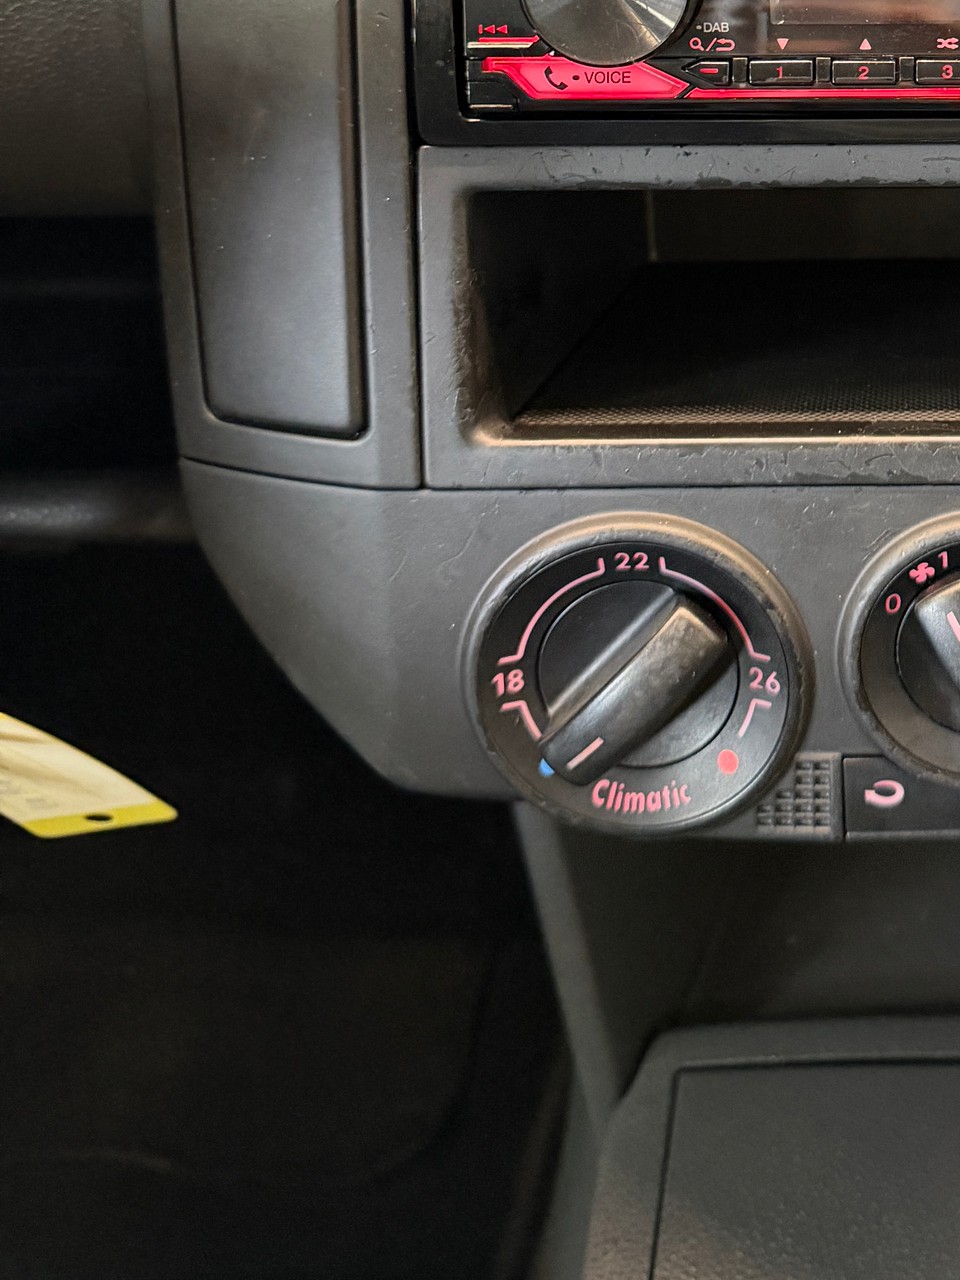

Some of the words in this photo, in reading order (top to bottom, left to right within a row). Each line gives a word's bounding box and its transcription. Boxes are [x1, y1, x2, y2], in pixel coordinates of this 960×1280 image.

[703, 21, 729, 33] DAB
[584, 71, 632, 84] VOICE
[776, 66, 784, 79] 1
[858, 66, 868, 79] 2
[941, 66, 952, 79] 3
[614, 552, 650, 570] 22
[939, 551, 950, 570] 1
[491, 669, 526, 697] 18
[749, 667, 781, 696] 26
[591, 778, 692, 814] Climatic
